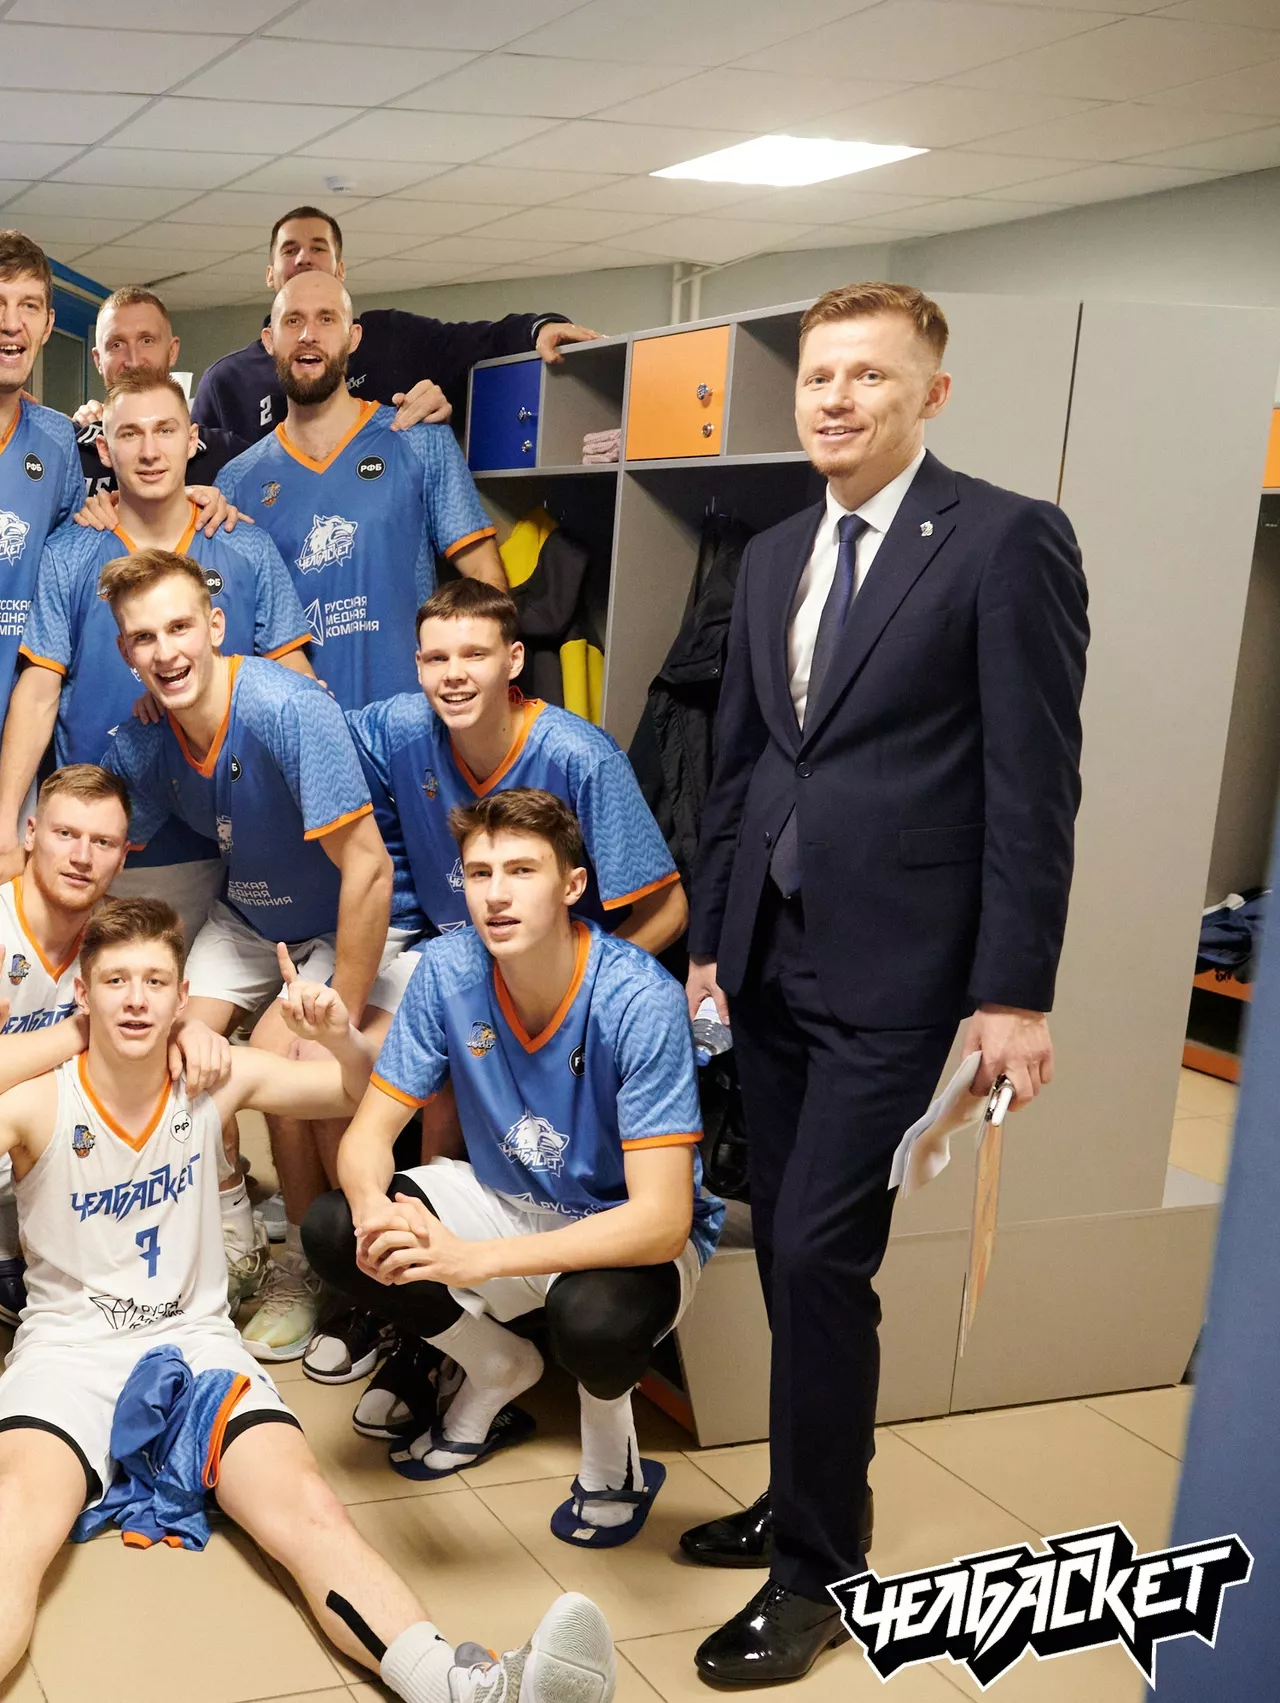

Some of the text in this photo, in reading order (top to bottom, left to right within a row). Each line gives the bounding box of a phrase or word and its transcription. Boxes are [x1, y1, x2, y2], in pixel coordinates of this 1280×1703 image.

[26, 462, 42, 472] РФБ
[361, 463, 382, 473] РФБ
[206, 578, 222, 587] ФБ
[324, 596, 367, 614] РУССКАЯ
[325, 608, 367, 626] МЕДНАЯ
[325, 620, 380, 638] КОМПАНИЯ
[229, 880, 269, 890] ССКАЯ
[71, 1152, 201, 1224] ЧЕЛБАСКЕТ
[135, 1225, 161, 1279] 7
